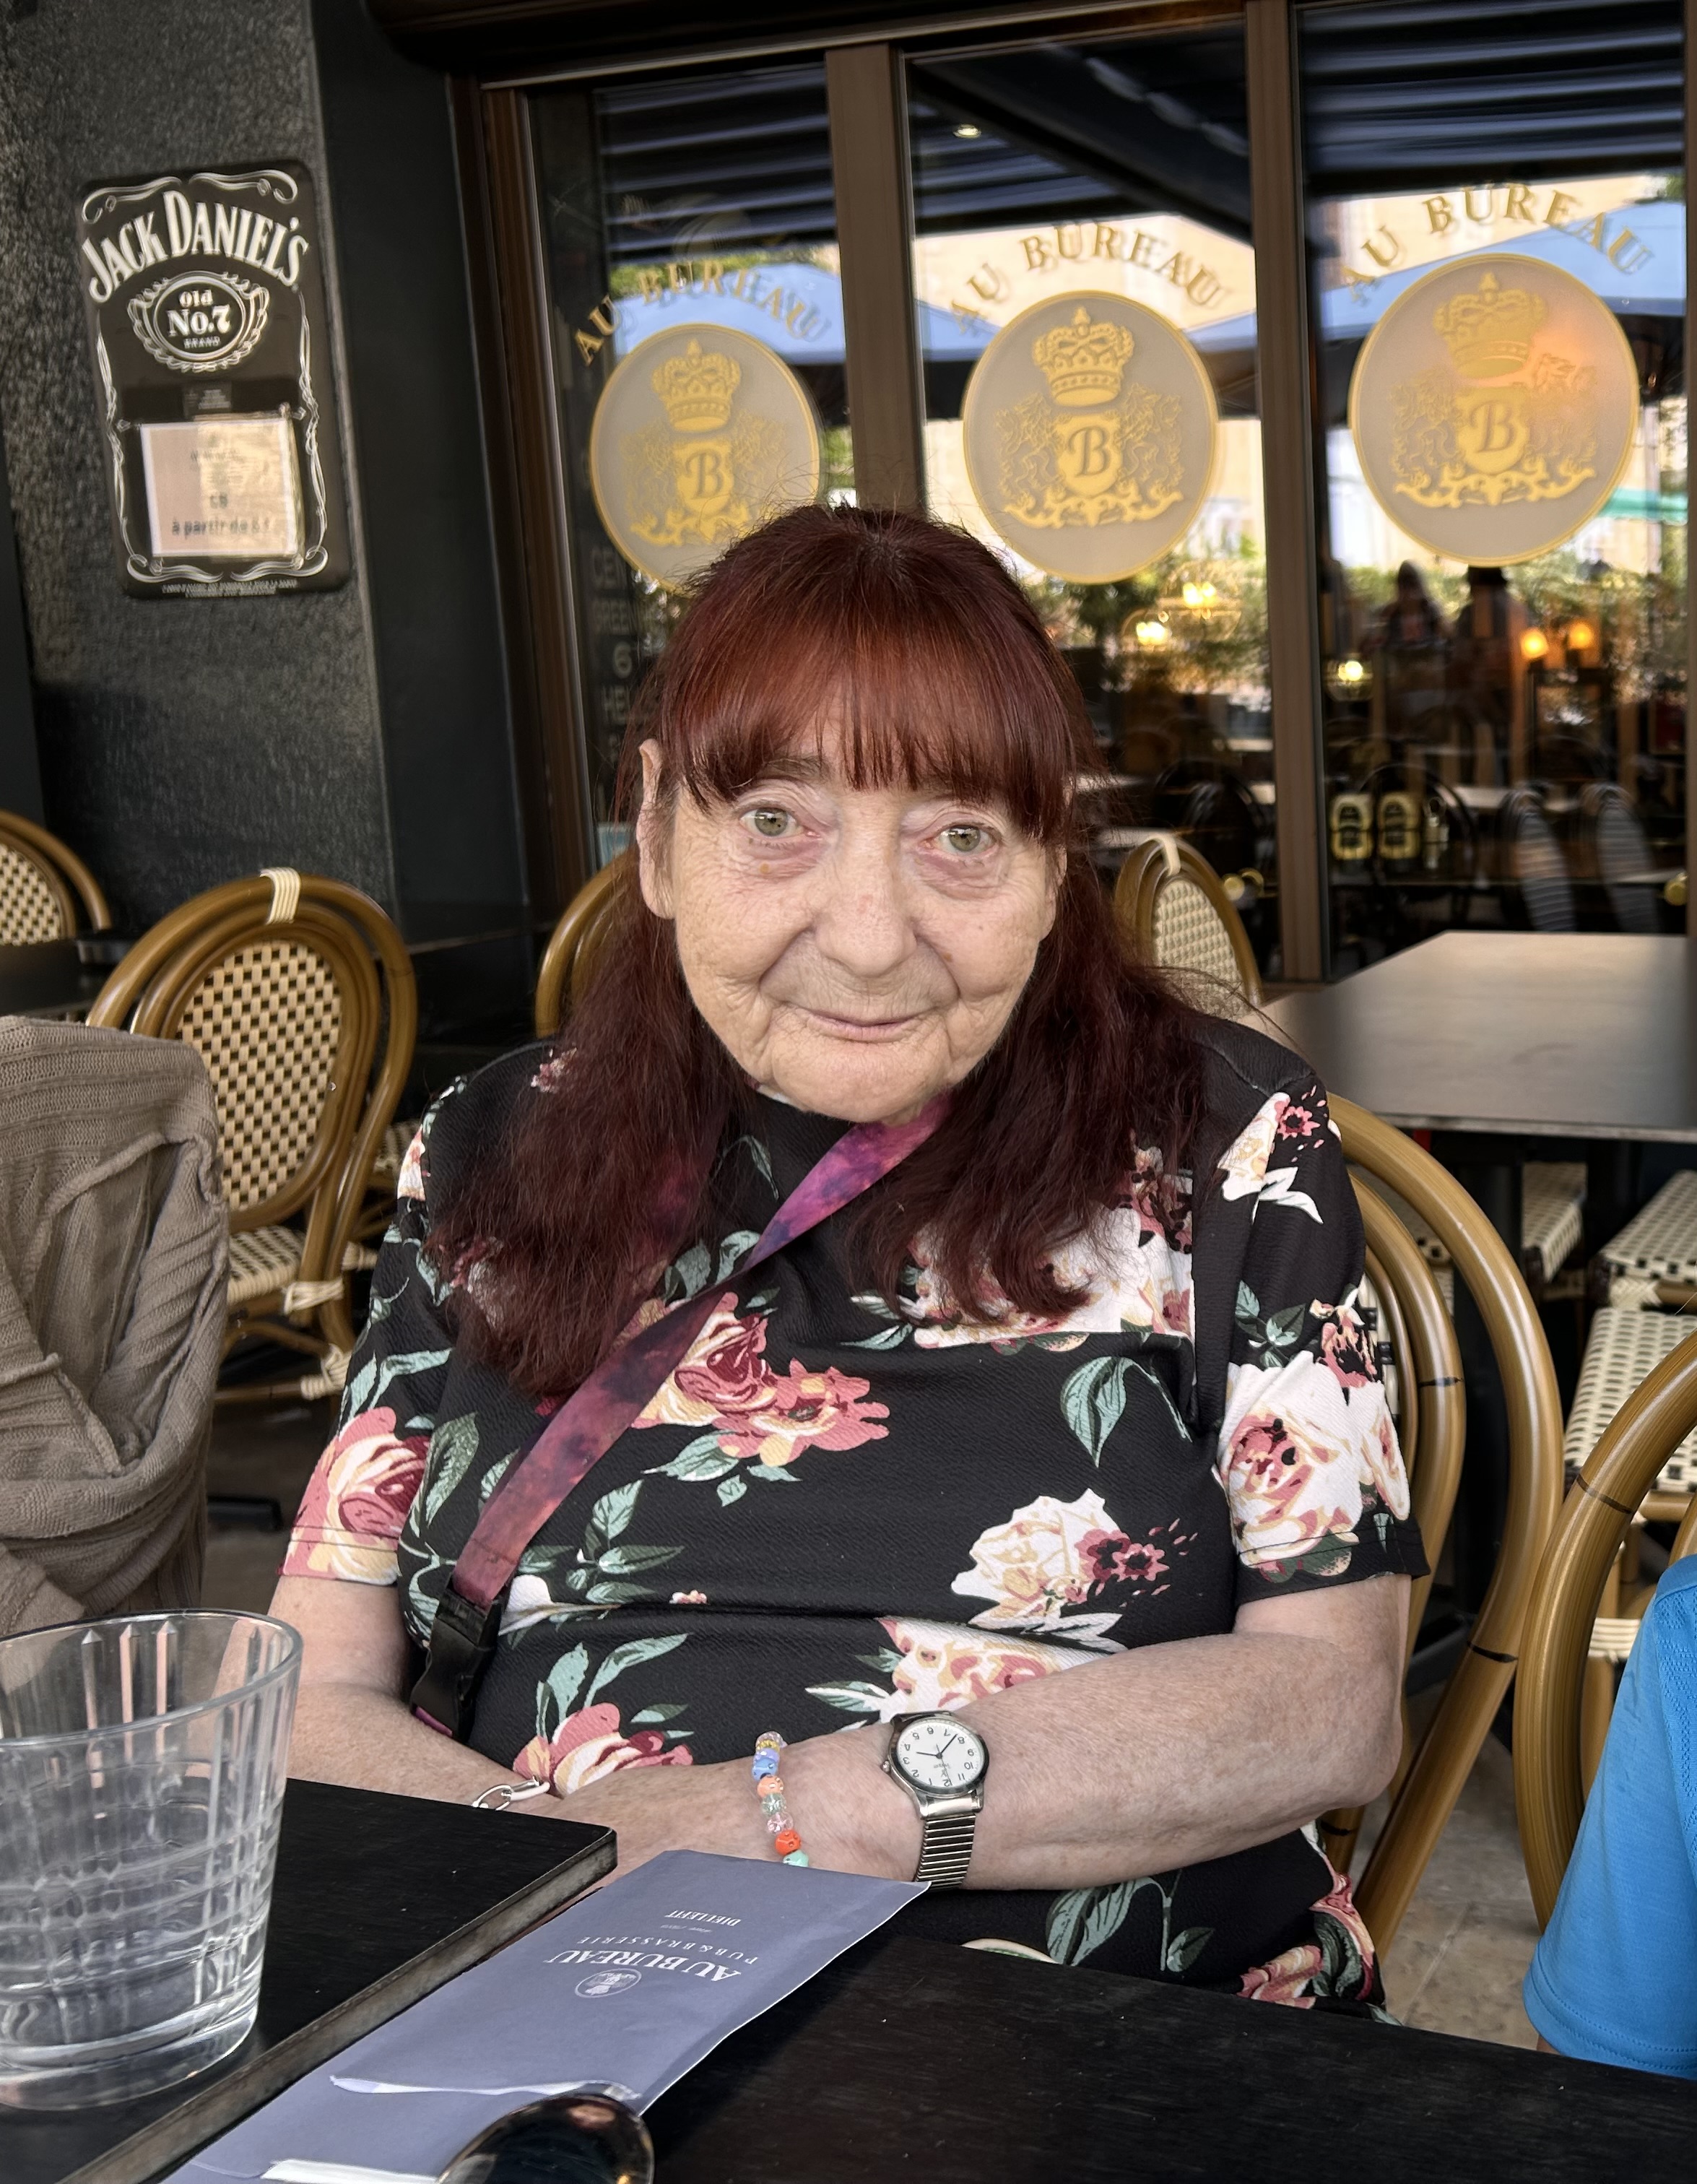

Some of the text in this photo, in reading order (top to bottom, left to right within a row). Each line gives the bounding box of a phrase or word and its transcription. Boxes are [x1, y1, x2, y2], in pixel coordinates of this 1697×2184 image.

[1422, 182, 1654, 274] BUREAU
[82, 190, 309, 303] JACK DANIEL'S
[950, 221, 1222, 334] AU BUREAU
[178, 289, 214, 308] Old
[574, 261, 823, 366] AU BUREAU
[664, 1910, 741, 1926] DIEULEFIT
[577, 1936, 695, 1950] BRASSERIE
[715, 1948, 759, 1964] PUB
[542, 1949, 742, 1982] AU BUREAU
